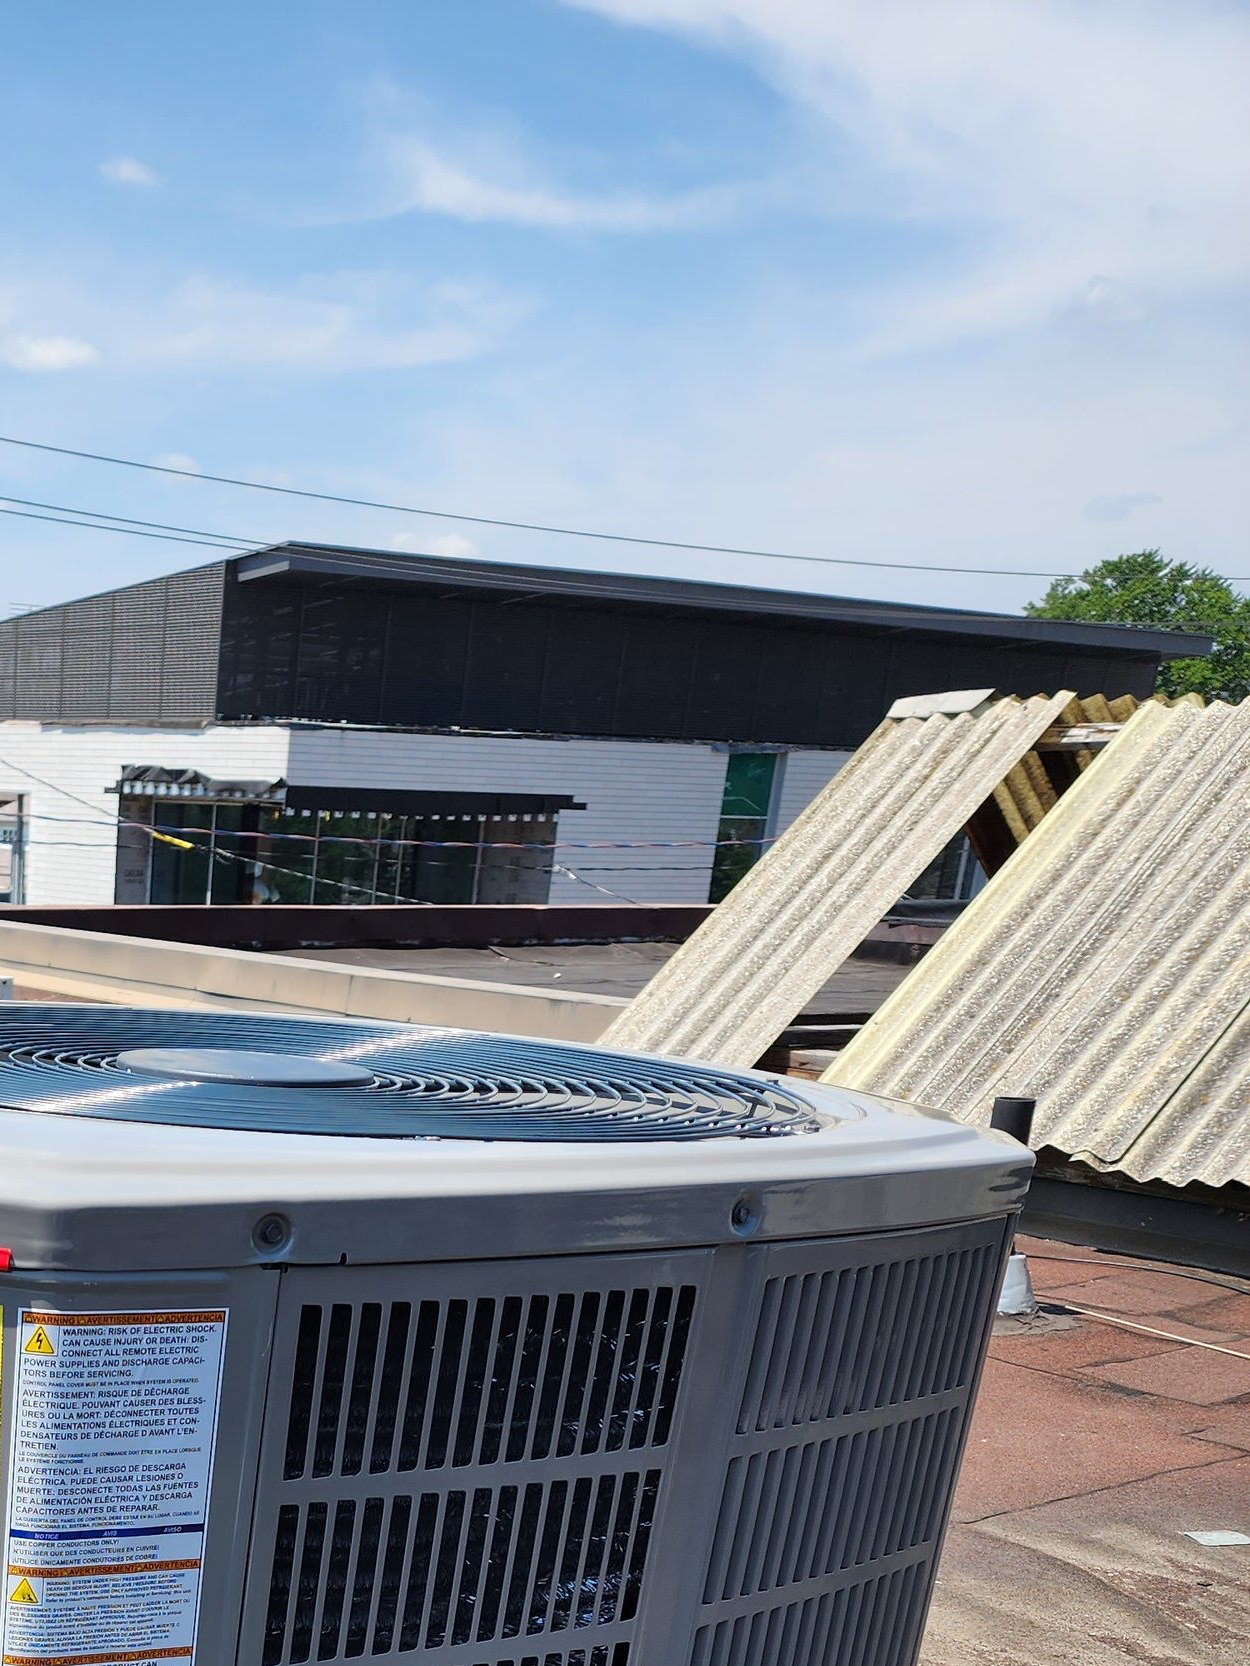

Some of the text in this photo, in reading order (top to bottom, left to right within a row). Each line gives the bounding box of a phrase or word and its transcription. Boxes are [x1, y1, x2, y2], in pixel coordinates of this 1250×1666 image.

[32, 1313, 223, 1324] WARNING AVERTISSEMENT ADVERTENCIA
[62, 1328, 106, 1336] WARNING:
[130, 1327, 142, 1335] OF
[143, 1326, 184, 1334] ELECTRIC
[186, 1325, 216, 1333] SHOCK.
[62, 1339, 81, 1347] CAN
[83, 1339, 112, 1347] CAUSE
[114, 1338, 144, 1346] INJURY
[146, 1337, 158, 1345] OR
[160, 1336, 189, 1344] DEATH:
[61, 1349, 103, 1358] CONNECT
[122, 1347, 157, 1356] REMOTE
[159, 1346, 199, 1355] ELECTRIC
[23, 1358, 57, 1368] POWER
[59, 1360, 100, 1368] SUPPLIES
[122, 1358, 170, 1367] DISCHARGE
[172, 1356, 205, 1366] CAPACI-
[23, 1369, 133, 1379] TORS BEFORE SERVICING.
[18, 1467, 81, 1475] ADVERTENCIA:
[96, 1466, 127, 1474] RIESGO
[142, 1462, 186, 1472] DESCARGA
[70, 1477, 98, 1485] PUEDE
[99, 1476, 134, 1484] CAUSAR
[136, 1472, 176, 1483] LESIONES
[176, 1472, 184, 1480] O
[17, 1481, 198, 1495] MUERTE: DESCONECTE TODAS LAS FUENTES
[30, 1494, 92, 1505] ALIMENTACIÓN
[94, 1495, 140, 1504] ELÉCTRICA
[149, 1491, 192, 1501] DESCARGA
[16, 1507, 76, 1515] CAPACITORES
[77, 1506, 104, 1514] ANTES
[57, 1540, 100, 1548] CONDUCTORS
